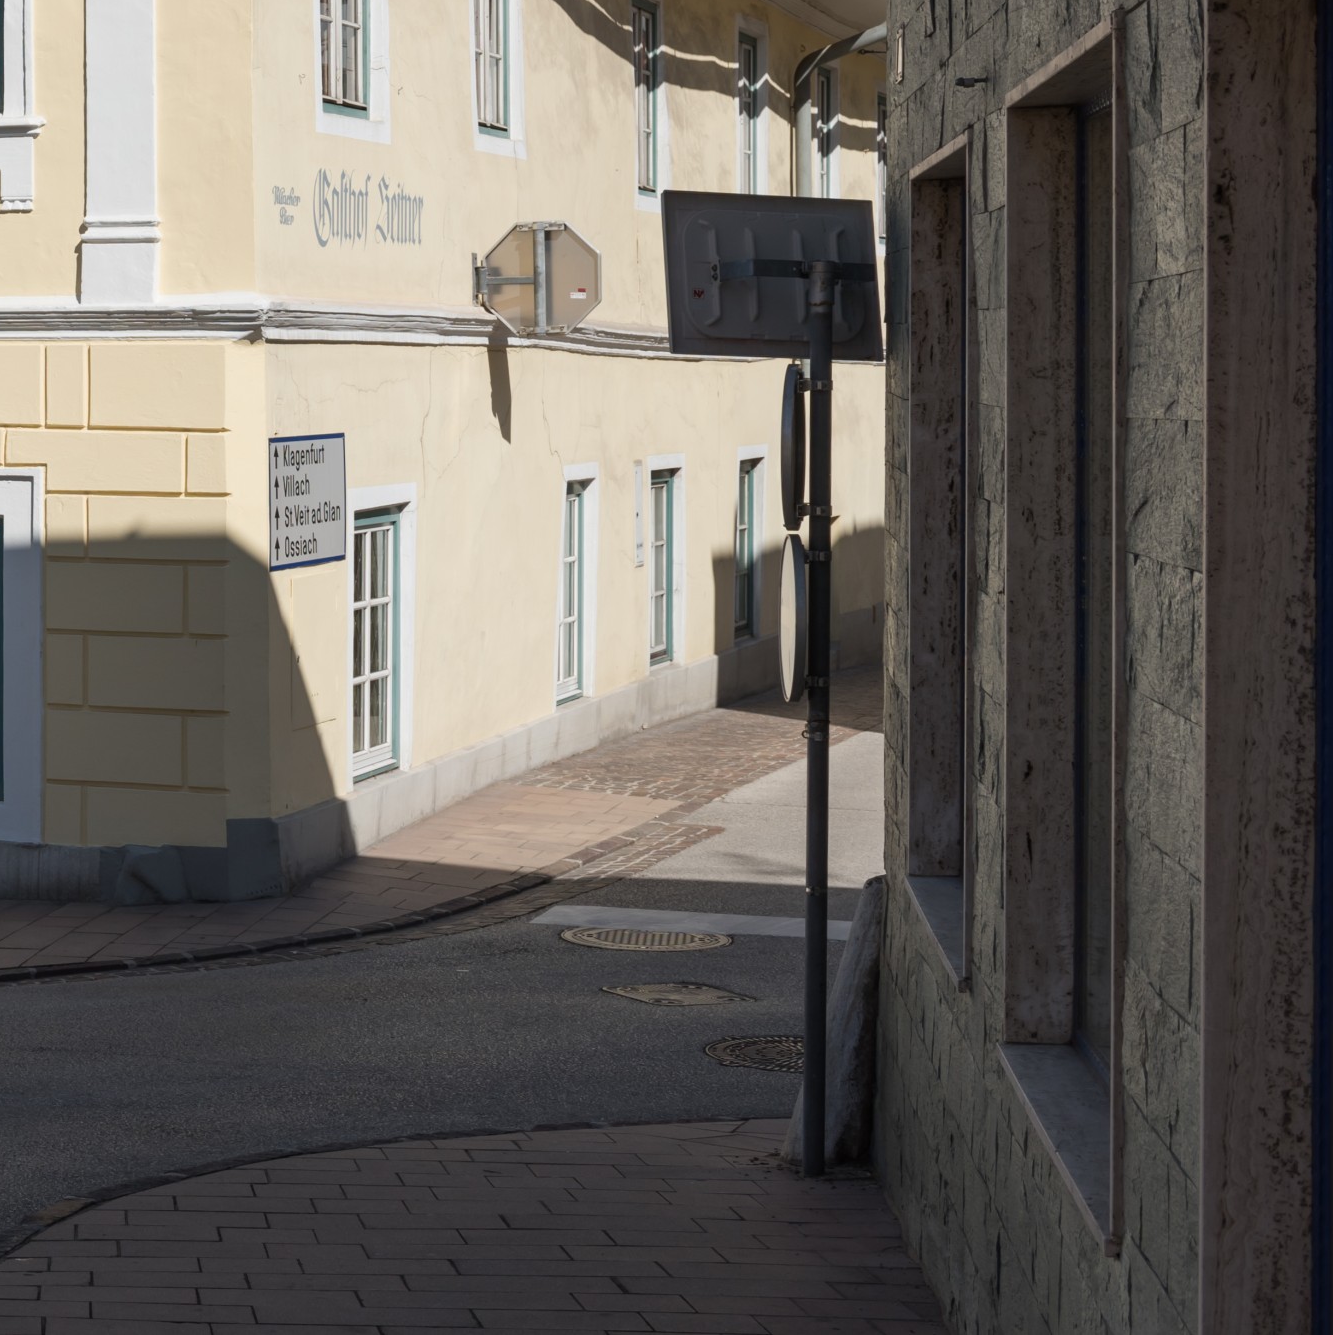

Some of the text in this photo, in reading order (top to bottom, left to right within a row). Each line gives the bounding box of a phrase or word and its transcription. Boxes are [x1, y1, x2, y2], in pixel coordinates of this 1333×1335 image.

[313, 168, 424, 250] Gasthof Seitner
[283, 443, 325, 471] Klagenfurt
[282, 474, 310, 497] Villach
[284, 532, 318, 558] Ossiach
